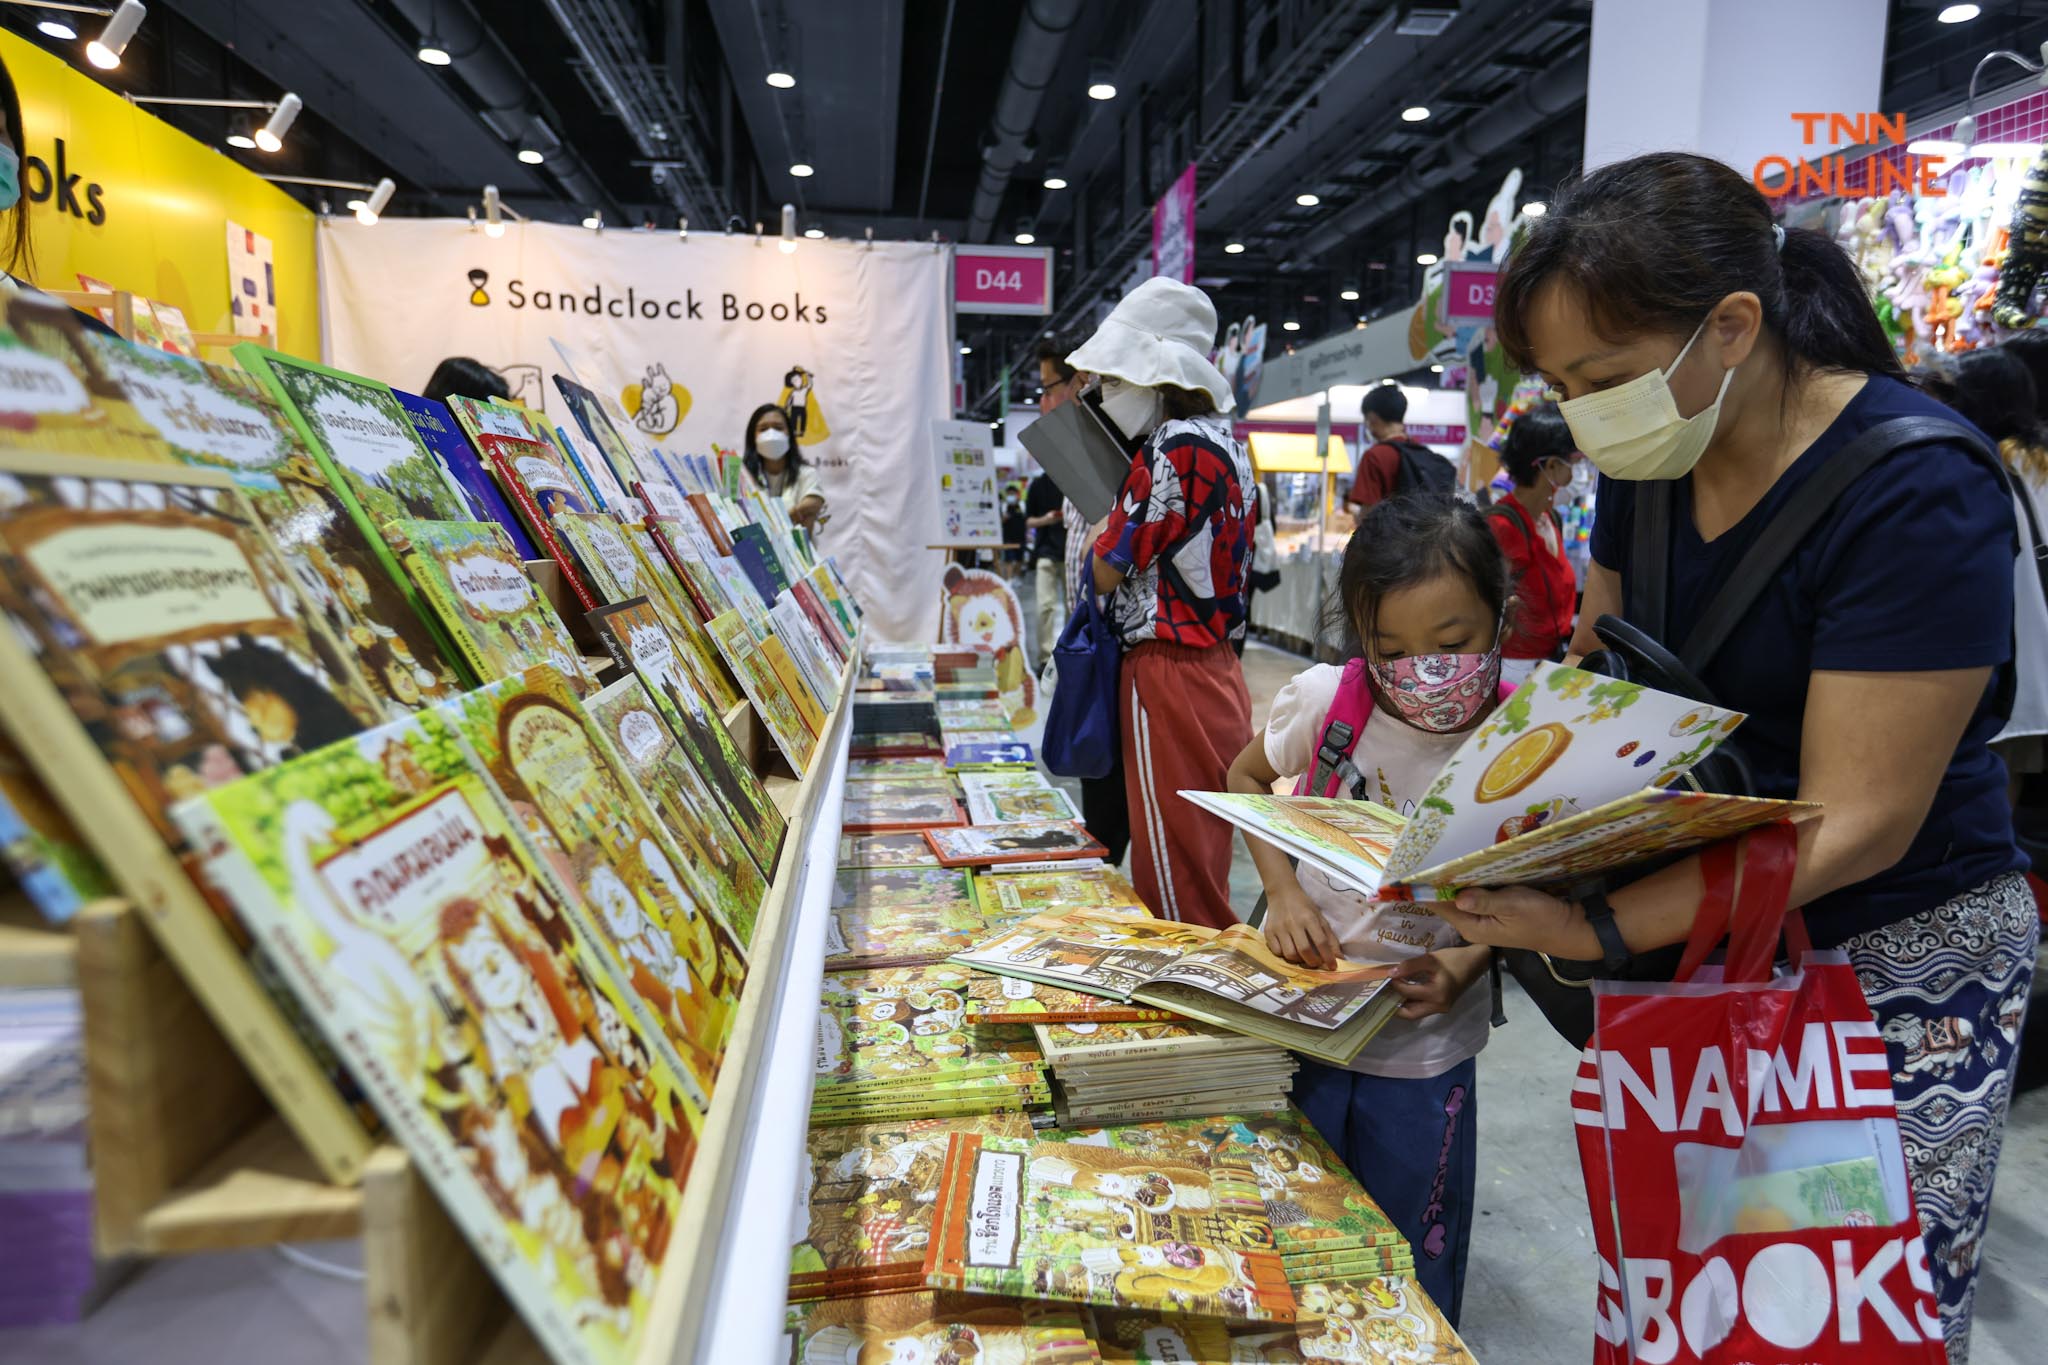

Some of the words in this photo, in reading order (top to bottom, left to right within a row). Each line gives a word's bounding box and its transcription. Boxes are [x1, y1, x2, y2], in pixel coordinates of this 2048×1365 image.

[975, 268, 1022, 291] D44
[507, 279, 704, 321] Sandclock
[722, 292, 828, 324] Books
[1377, 928, 1437, 948] yourself
